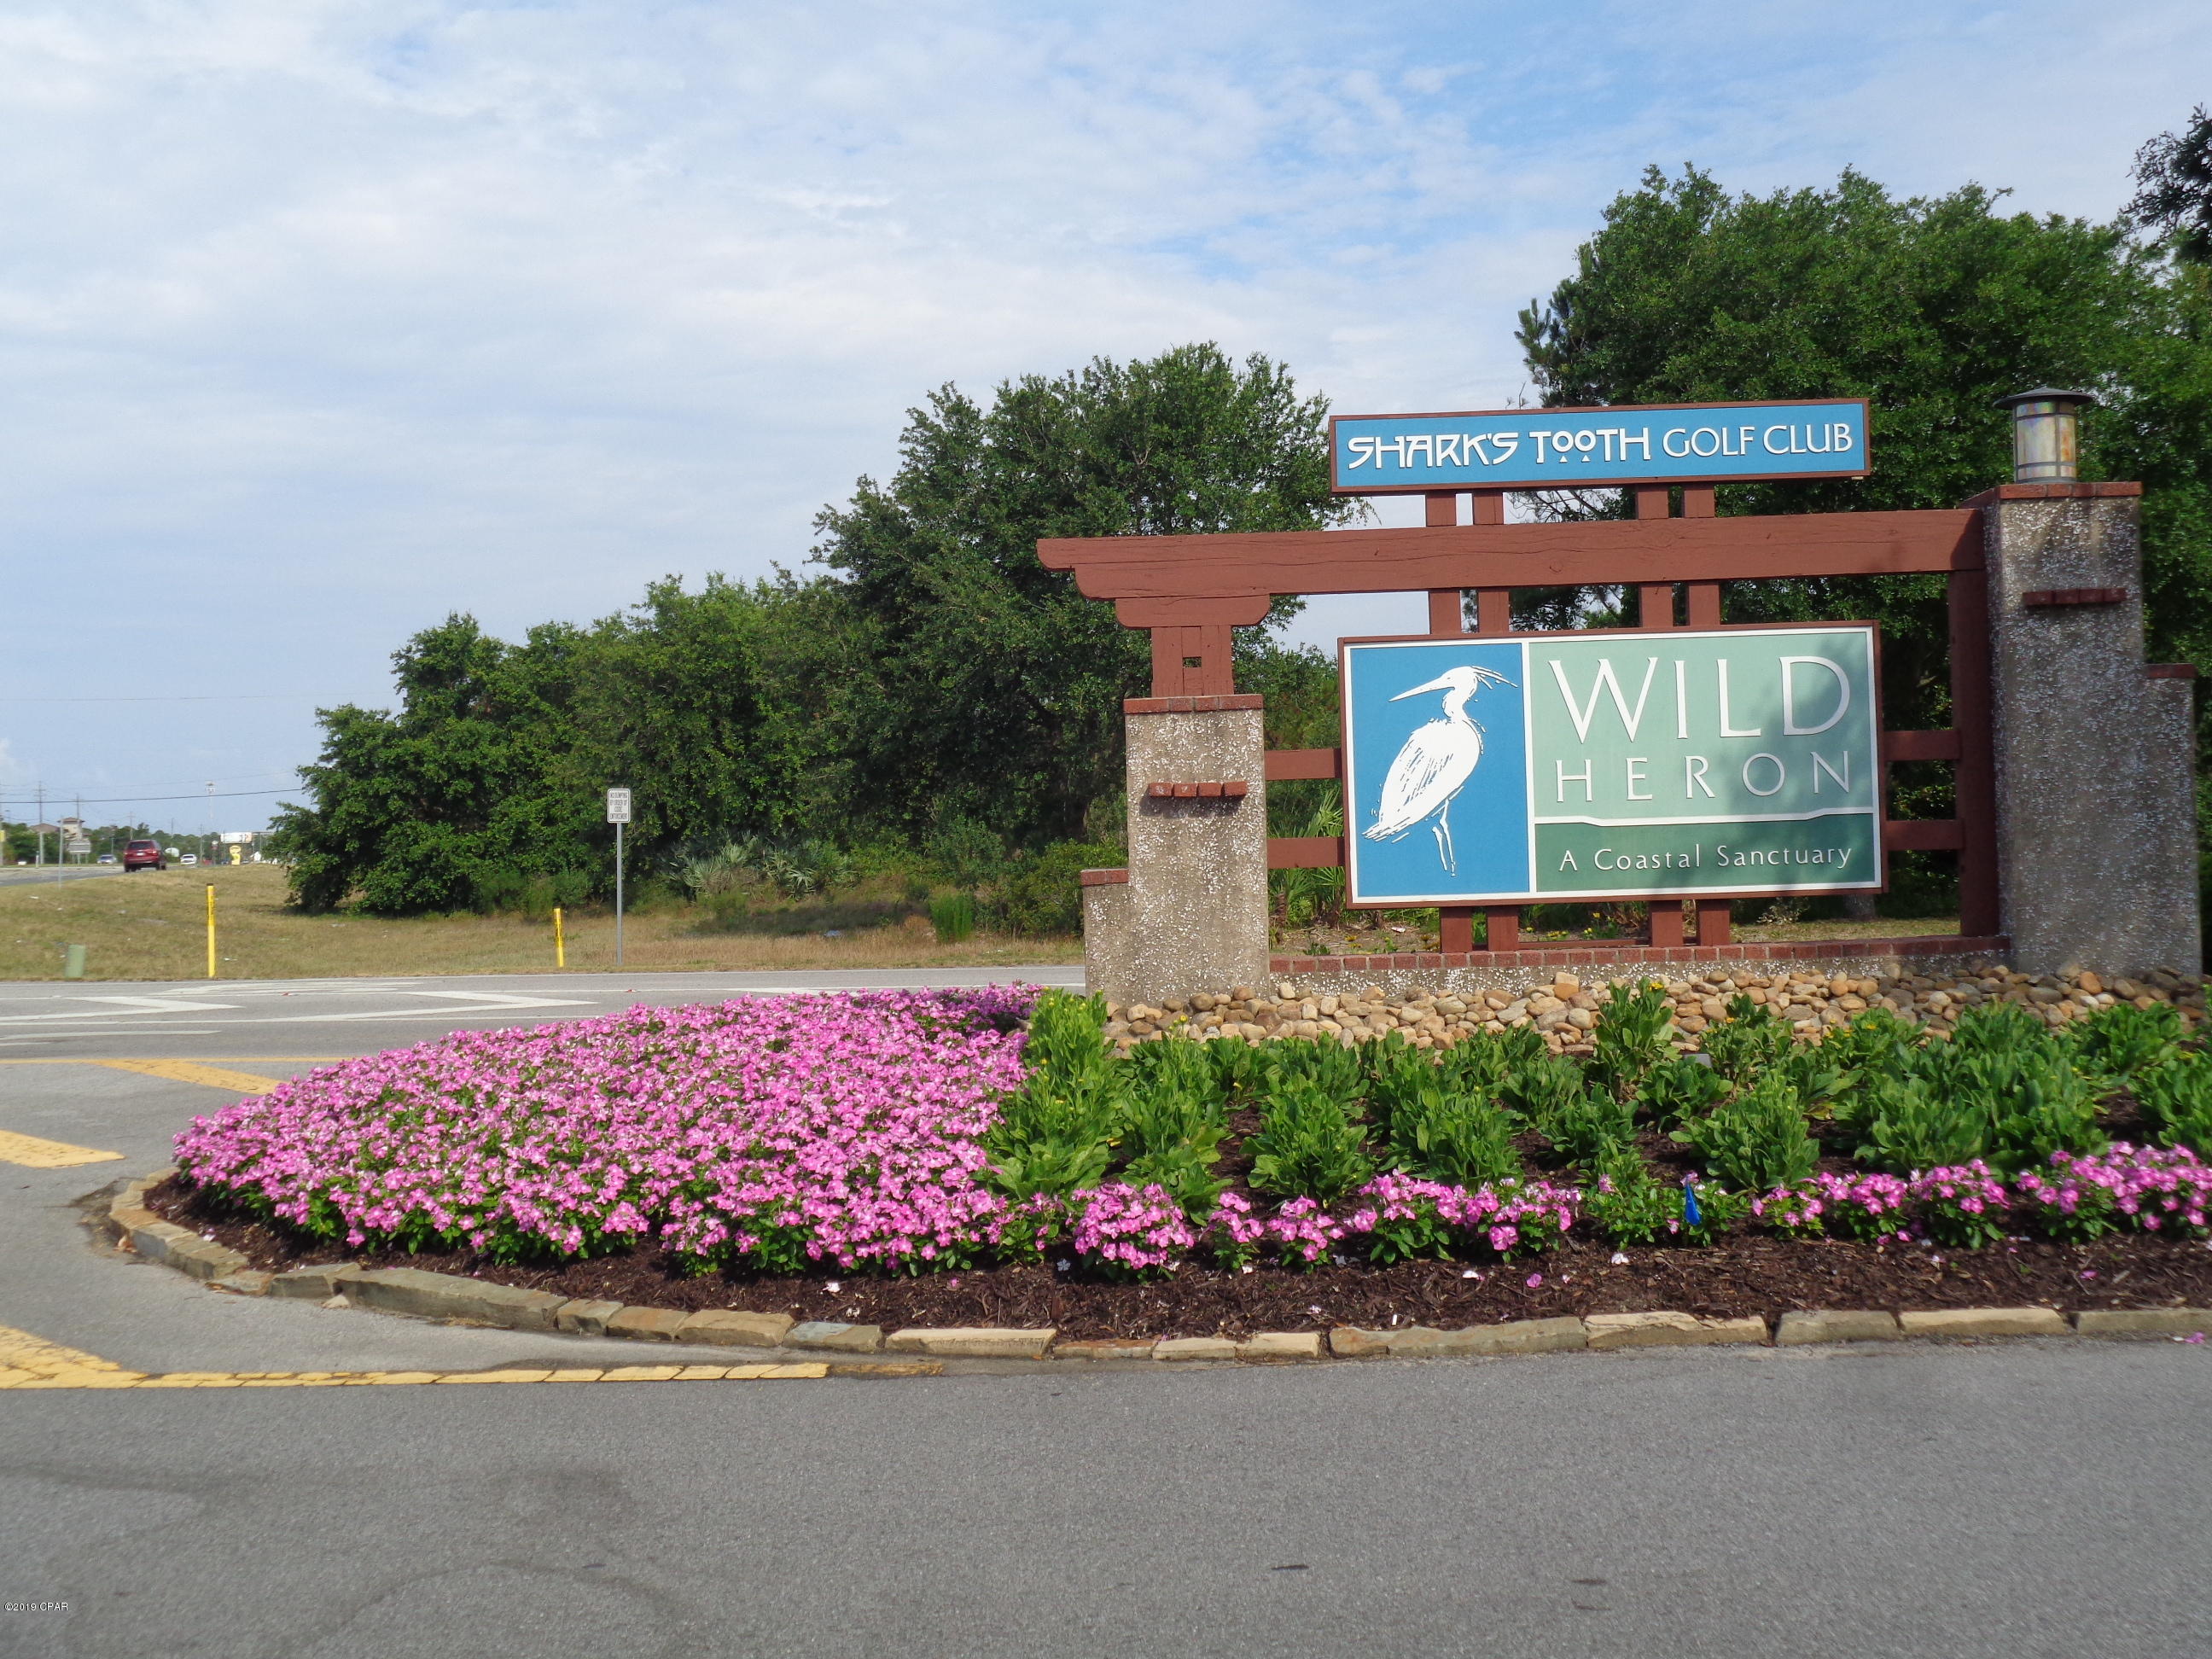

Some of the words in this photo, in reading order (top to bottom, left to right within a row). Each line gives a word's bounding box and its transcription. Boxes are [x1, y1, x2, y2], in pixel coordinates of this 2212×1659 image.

[1348, 432, 1519, 469] SHARK'S
[1528, 428, 1651, 463] TOOTH
[1662, 426, 1755, 457] GOLF
[1763, 422, 1854, 454] CLUB
[1548, 655, 1851, 744] WILD
[1556, 750, 1850, 802] HERON
[1558, 850, 1578, 871] A
[1593, 843, 1701, 871] Coastal
[1716, 844, 1853, 870] Sanctuary
